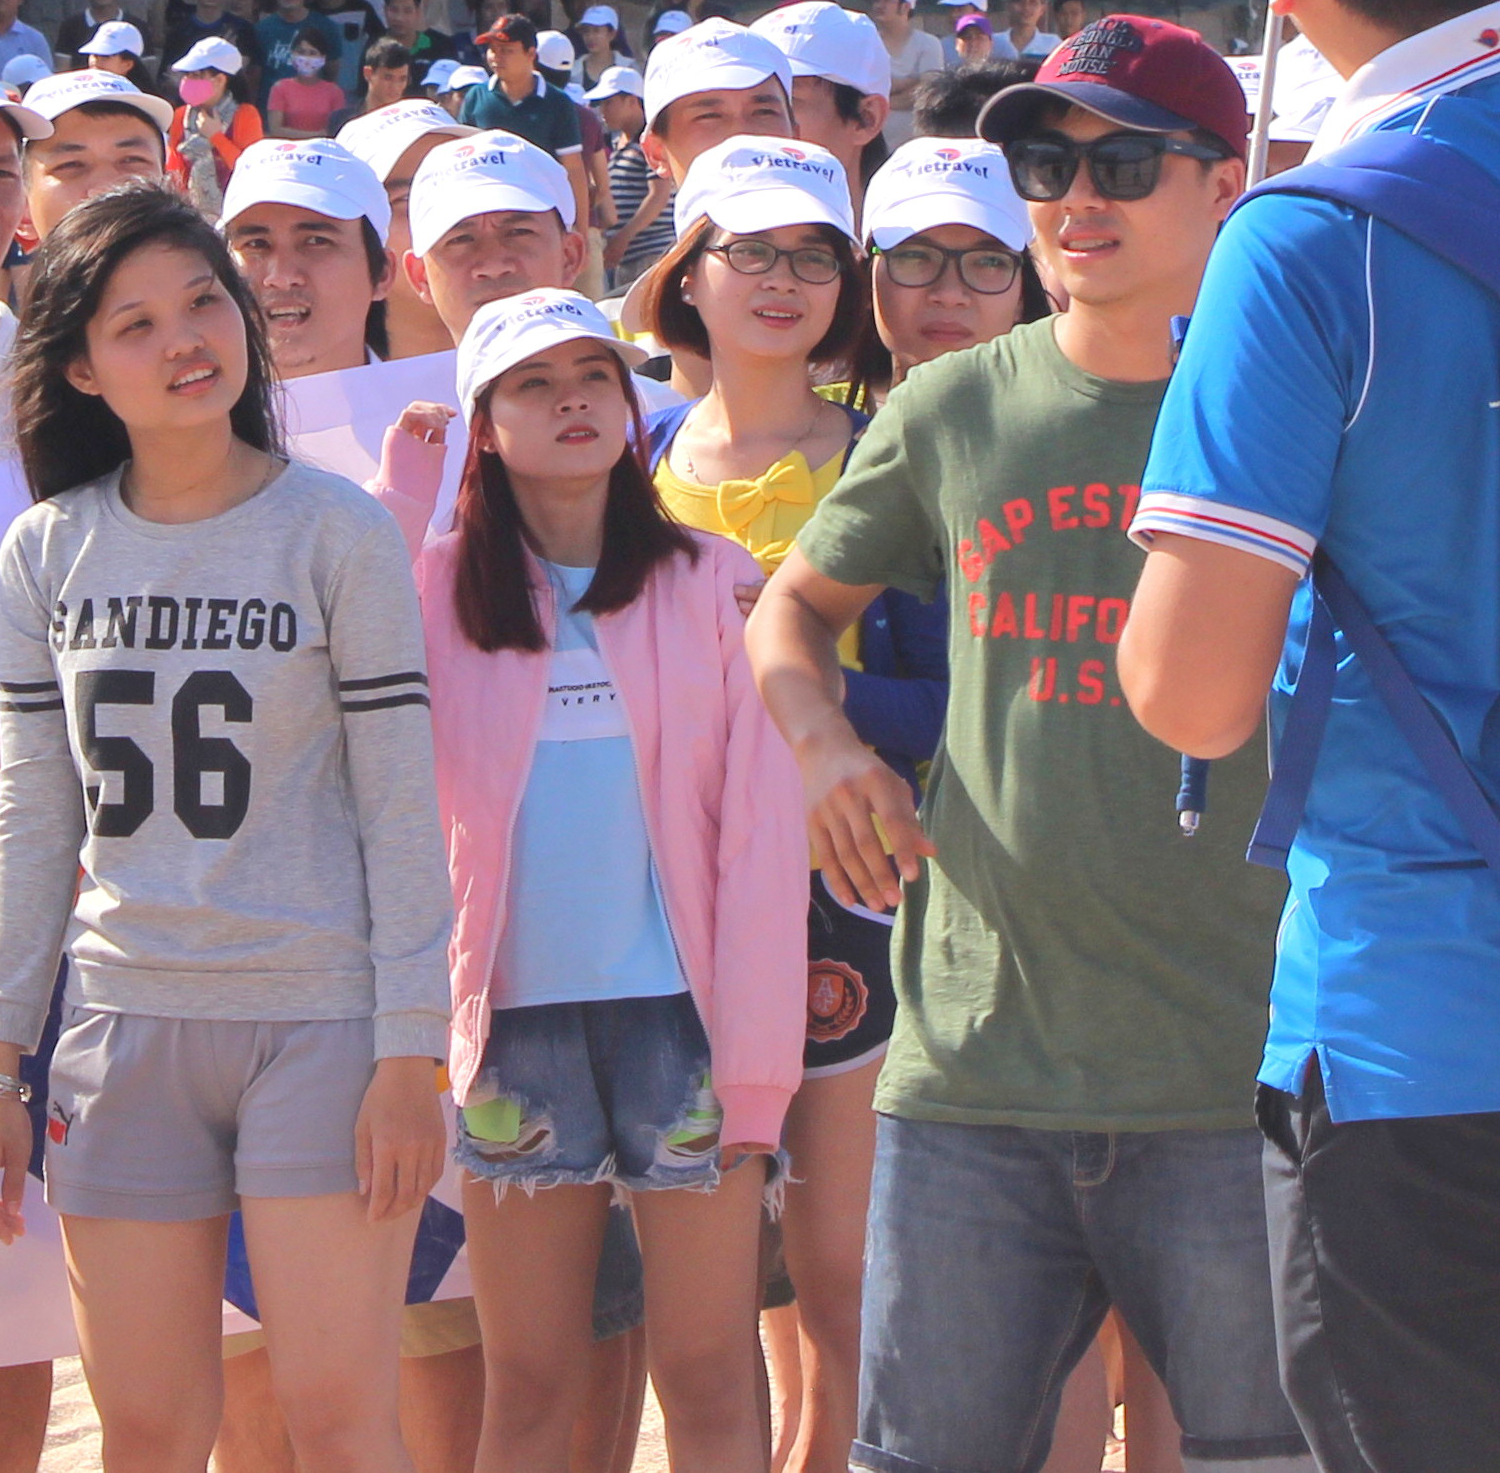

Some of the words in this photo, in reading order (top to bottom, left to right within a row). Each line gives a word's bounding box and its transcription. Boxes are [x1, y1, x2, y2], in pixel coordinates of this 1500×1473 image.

[752, 155, 835, 183] Vietravel
[905, 160, 989, 179] Vietravel
[957, 497, 1034, 583] GAP
[51, 596, 297, 653] SANDIEGO
[968, 591, 1131, 645] CALIFO
[75, 669, 253, 839] 56
